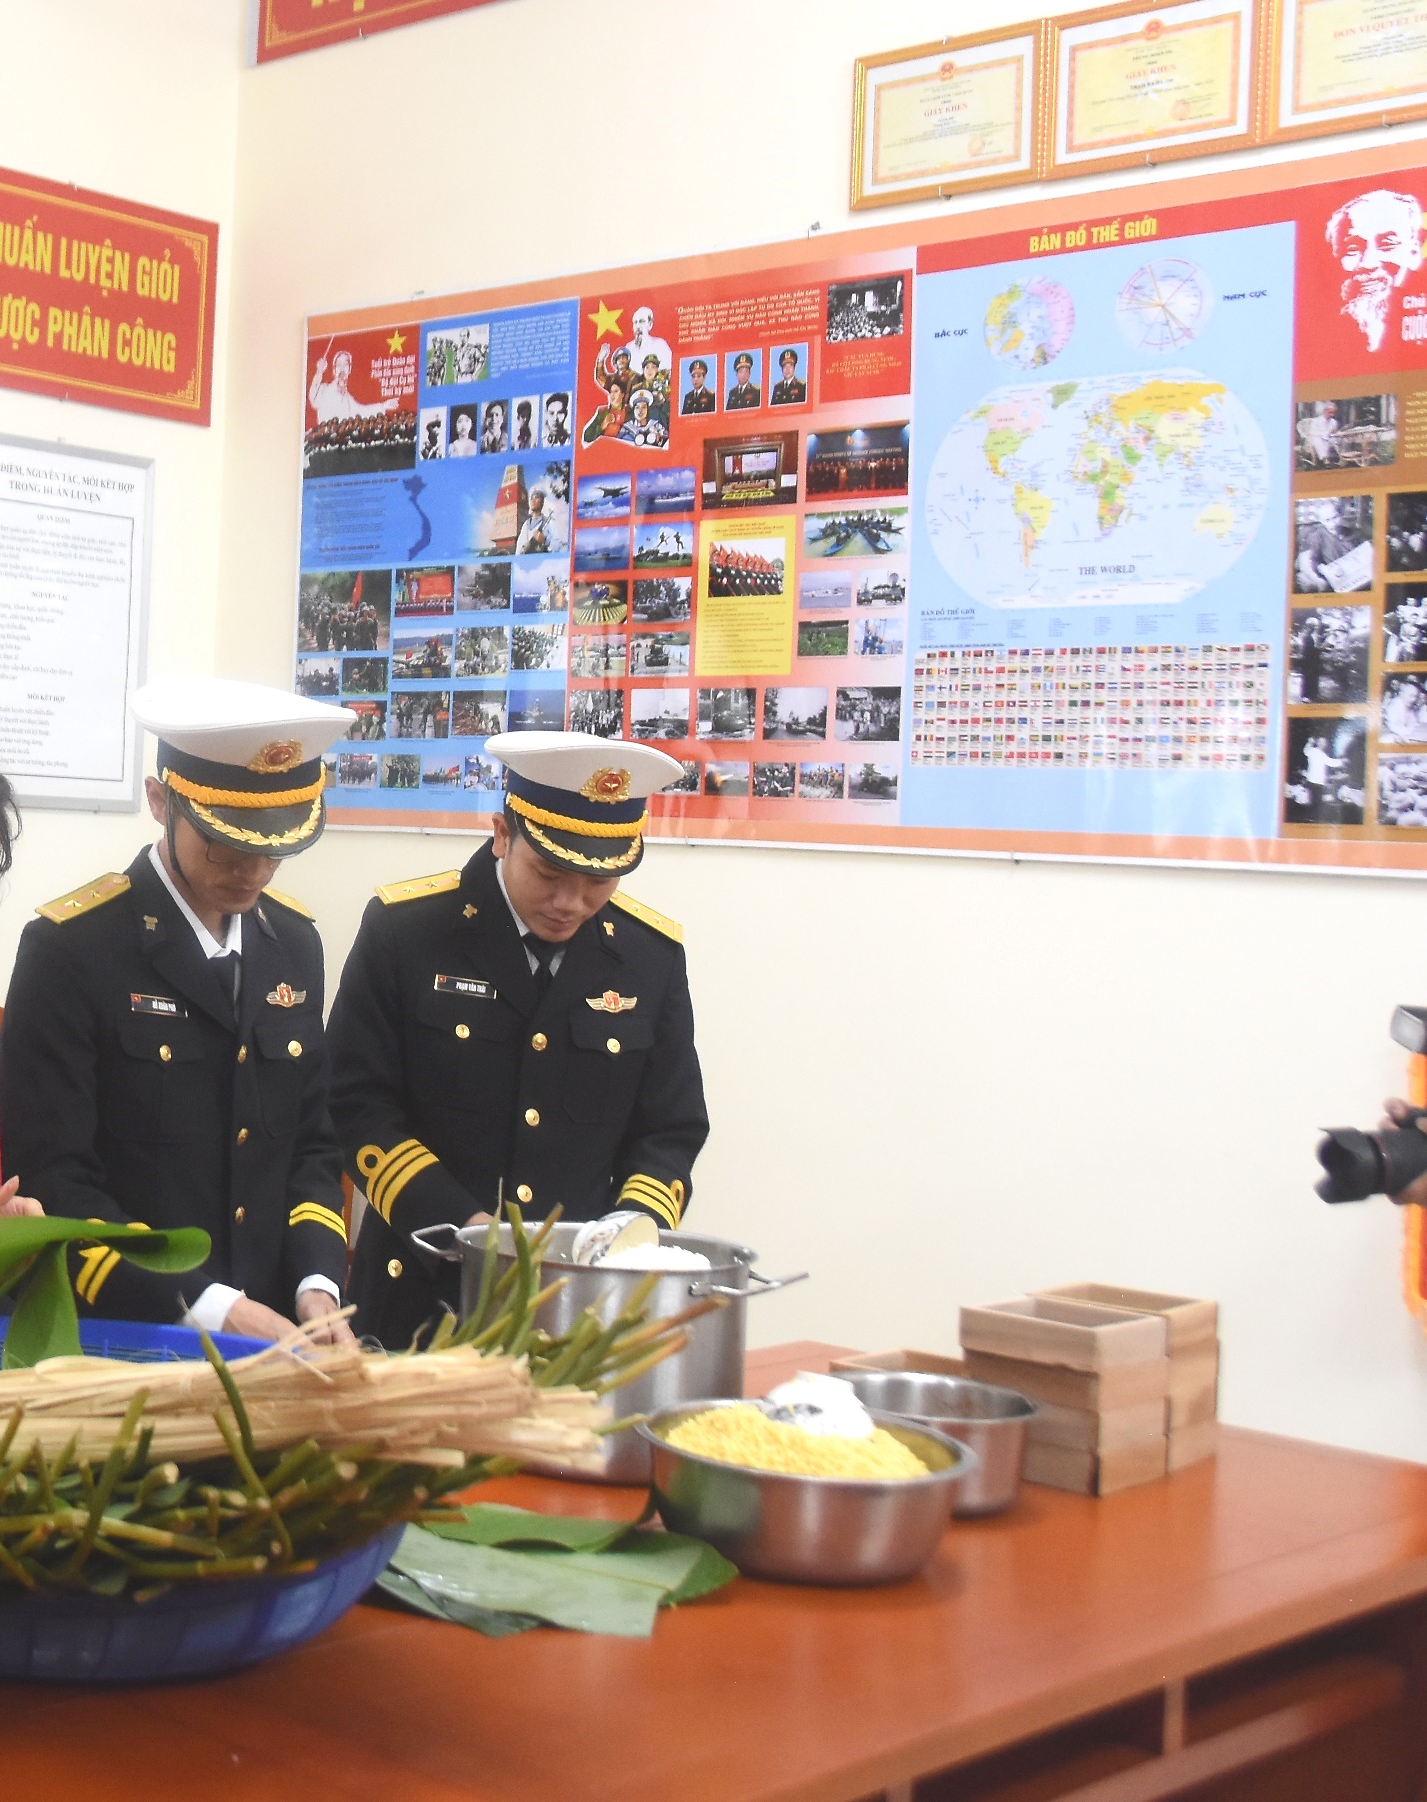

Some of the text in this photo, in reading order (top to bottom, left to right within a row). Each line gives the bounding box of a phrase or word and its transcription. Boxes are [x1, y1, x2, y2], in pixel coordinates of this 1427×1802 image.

[1029, 227, 1061, 253] BẢN
[1091, 218, 1120, 244] THẾ
[1124, 215, 1158, 240] GIỚI
[59, 239, 131, 296] LUYỆN
[136, 248, 180, 304] GIỎI
[47, 306, 110, 360] PHÂN
[116, 317, 176, 373] CÔNG
[9, 480, 101, 503] TRONG HUẤN LUYỆN
[26, 467, 60, 482] NGUYÊN
[82, 474, 99, 487] MỐI
[100, 476, 116, 490] KẾT
[118, 480, 135, 494] HỢP
[1078, 564, 1136, 576] THE WORLD
